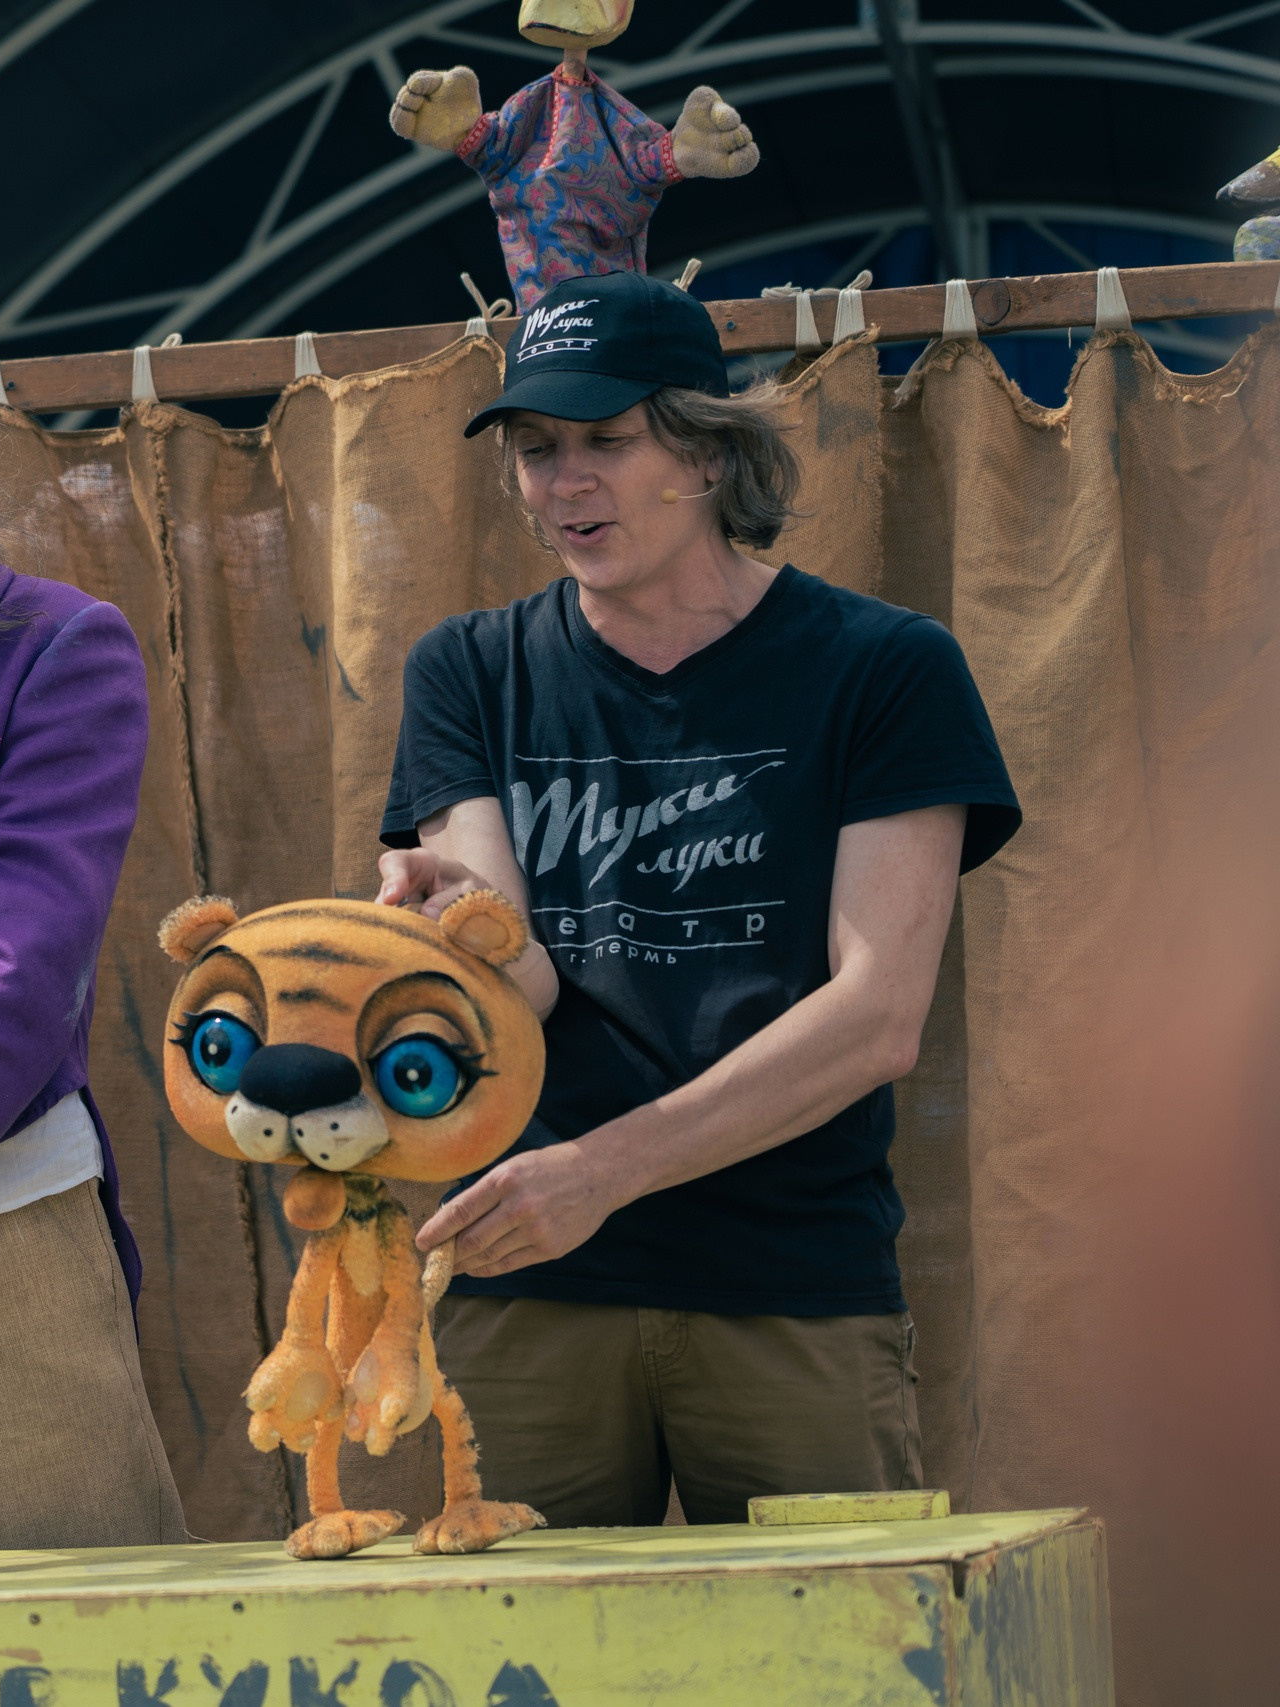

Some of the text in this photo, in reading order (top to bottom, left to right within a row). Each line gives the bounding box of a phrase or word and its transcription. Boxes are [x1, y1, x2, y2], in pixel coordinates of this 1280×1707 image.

[553, 317, 594, 333] луки
[510, 761, 786, 889] Муки
[636, 831, 767, 893] луки
[559, 913, 765, 939] еатр
